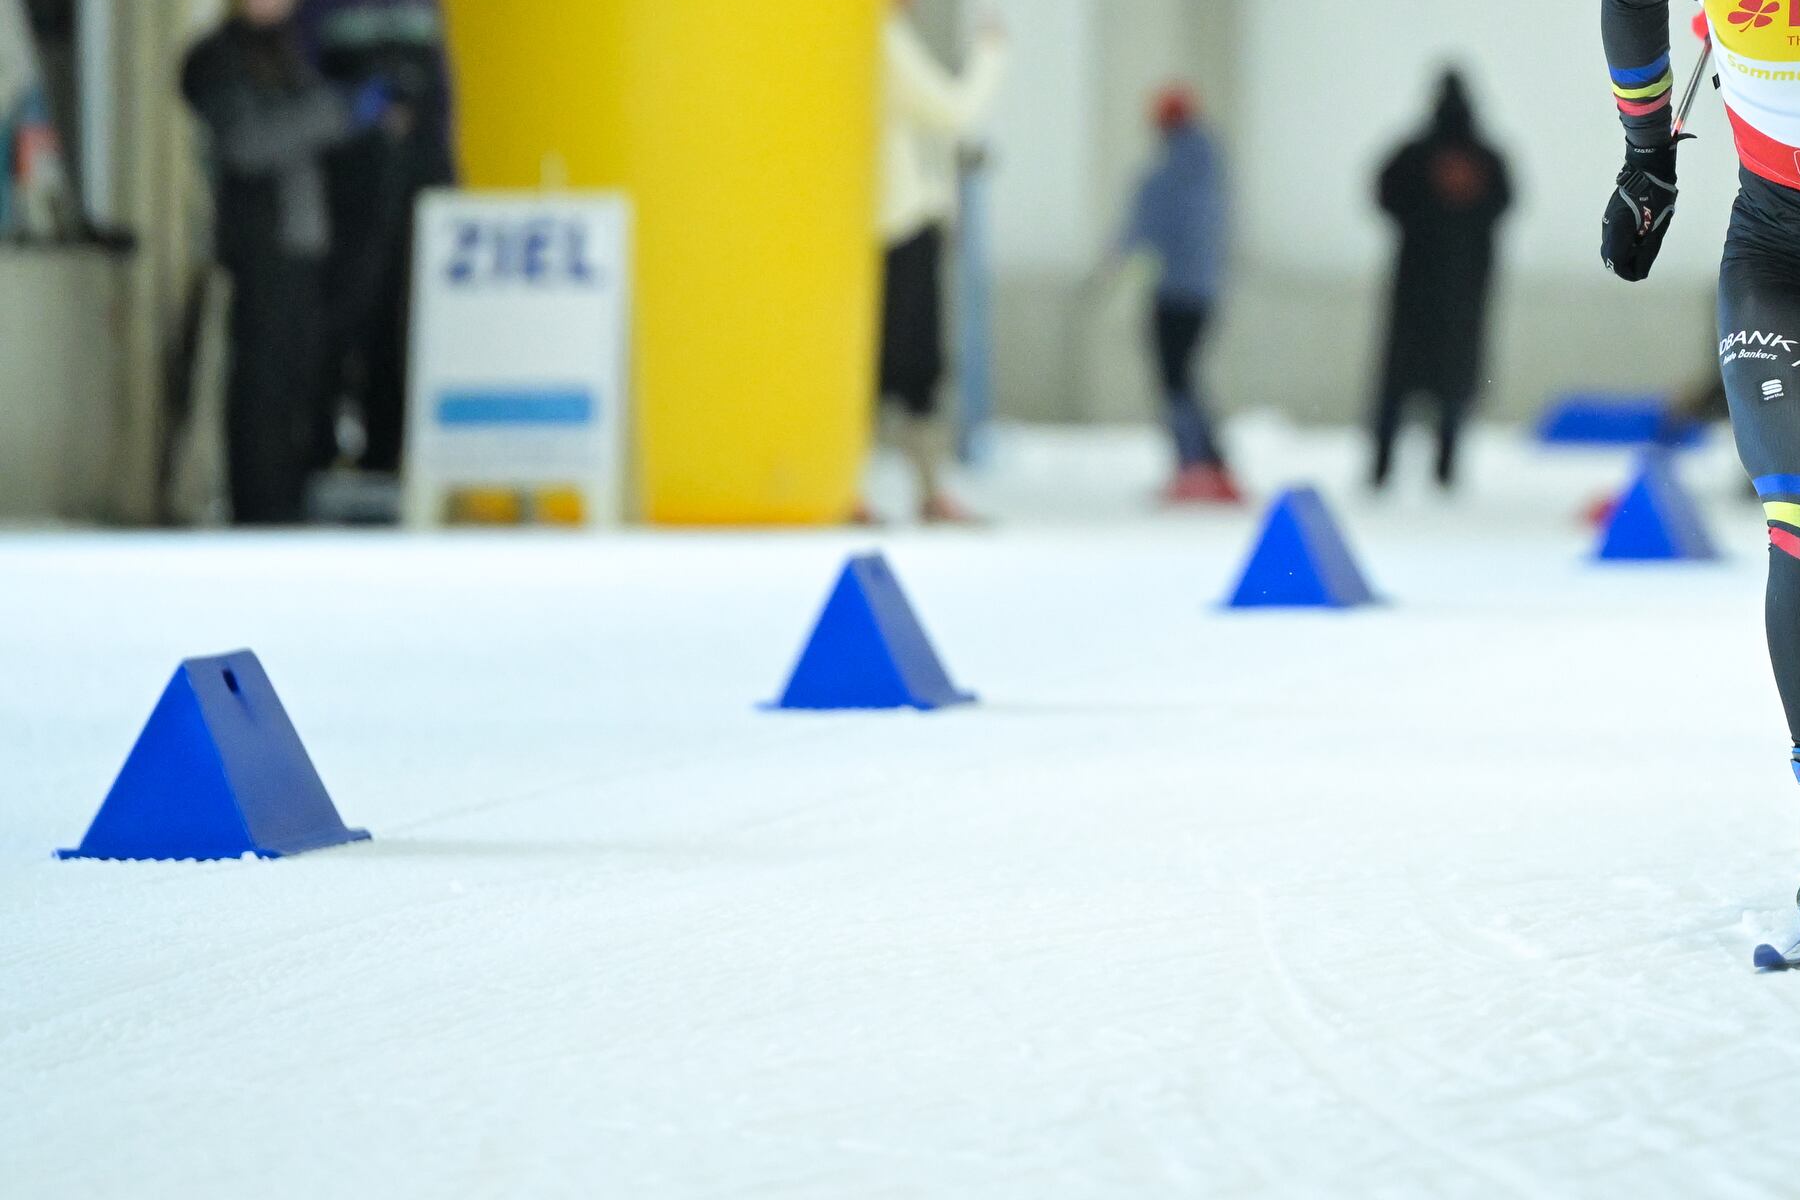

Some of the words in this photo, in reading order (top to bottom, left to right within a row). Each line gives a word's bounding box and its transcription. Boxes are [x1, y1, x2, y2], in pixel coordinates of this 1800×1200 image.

[448, 217, 596, 285] ZIEL
[1719, 330, 1799, 356] DBANK
[1738, 348, 1778, 361] Bankers
